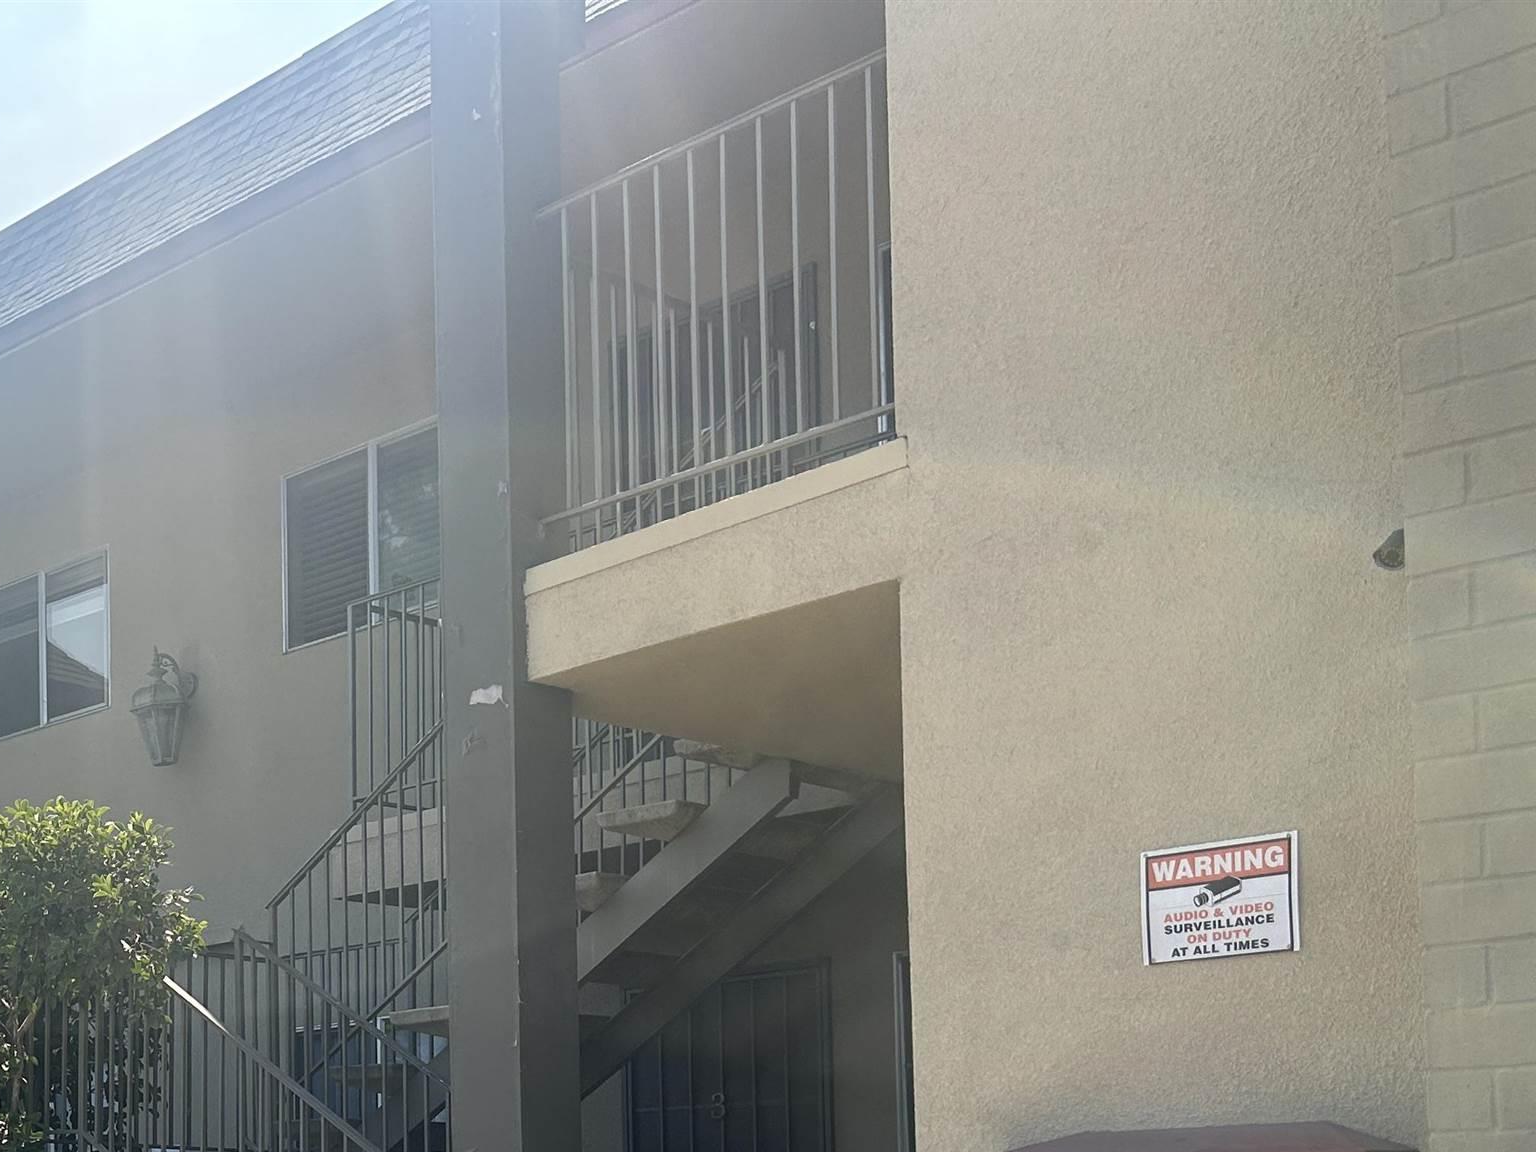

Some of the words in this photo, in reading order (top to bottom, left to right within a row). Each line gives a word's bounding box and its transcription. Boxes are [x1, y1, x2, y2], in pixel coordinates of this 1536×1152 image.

[1152, 846, 1284, 882] WARNING
[1164, 908, 1208, 923] AUDIO
[1213, 907, 1223, 917] &
[1229, 901, 1274, 915] VIDEO
[1164, 914, 1275, 934] SURVEILLANCE
[1187, 933, 1207, 944] ON
[1212, 928, 1252, 942] DUTY
[1171, 947, 1188, 957] AT
[1193, 944, 1219, 955] ALL
[1224, 938, 1269, 951] TIMES
[711, 1092, 726, 1119] 3
